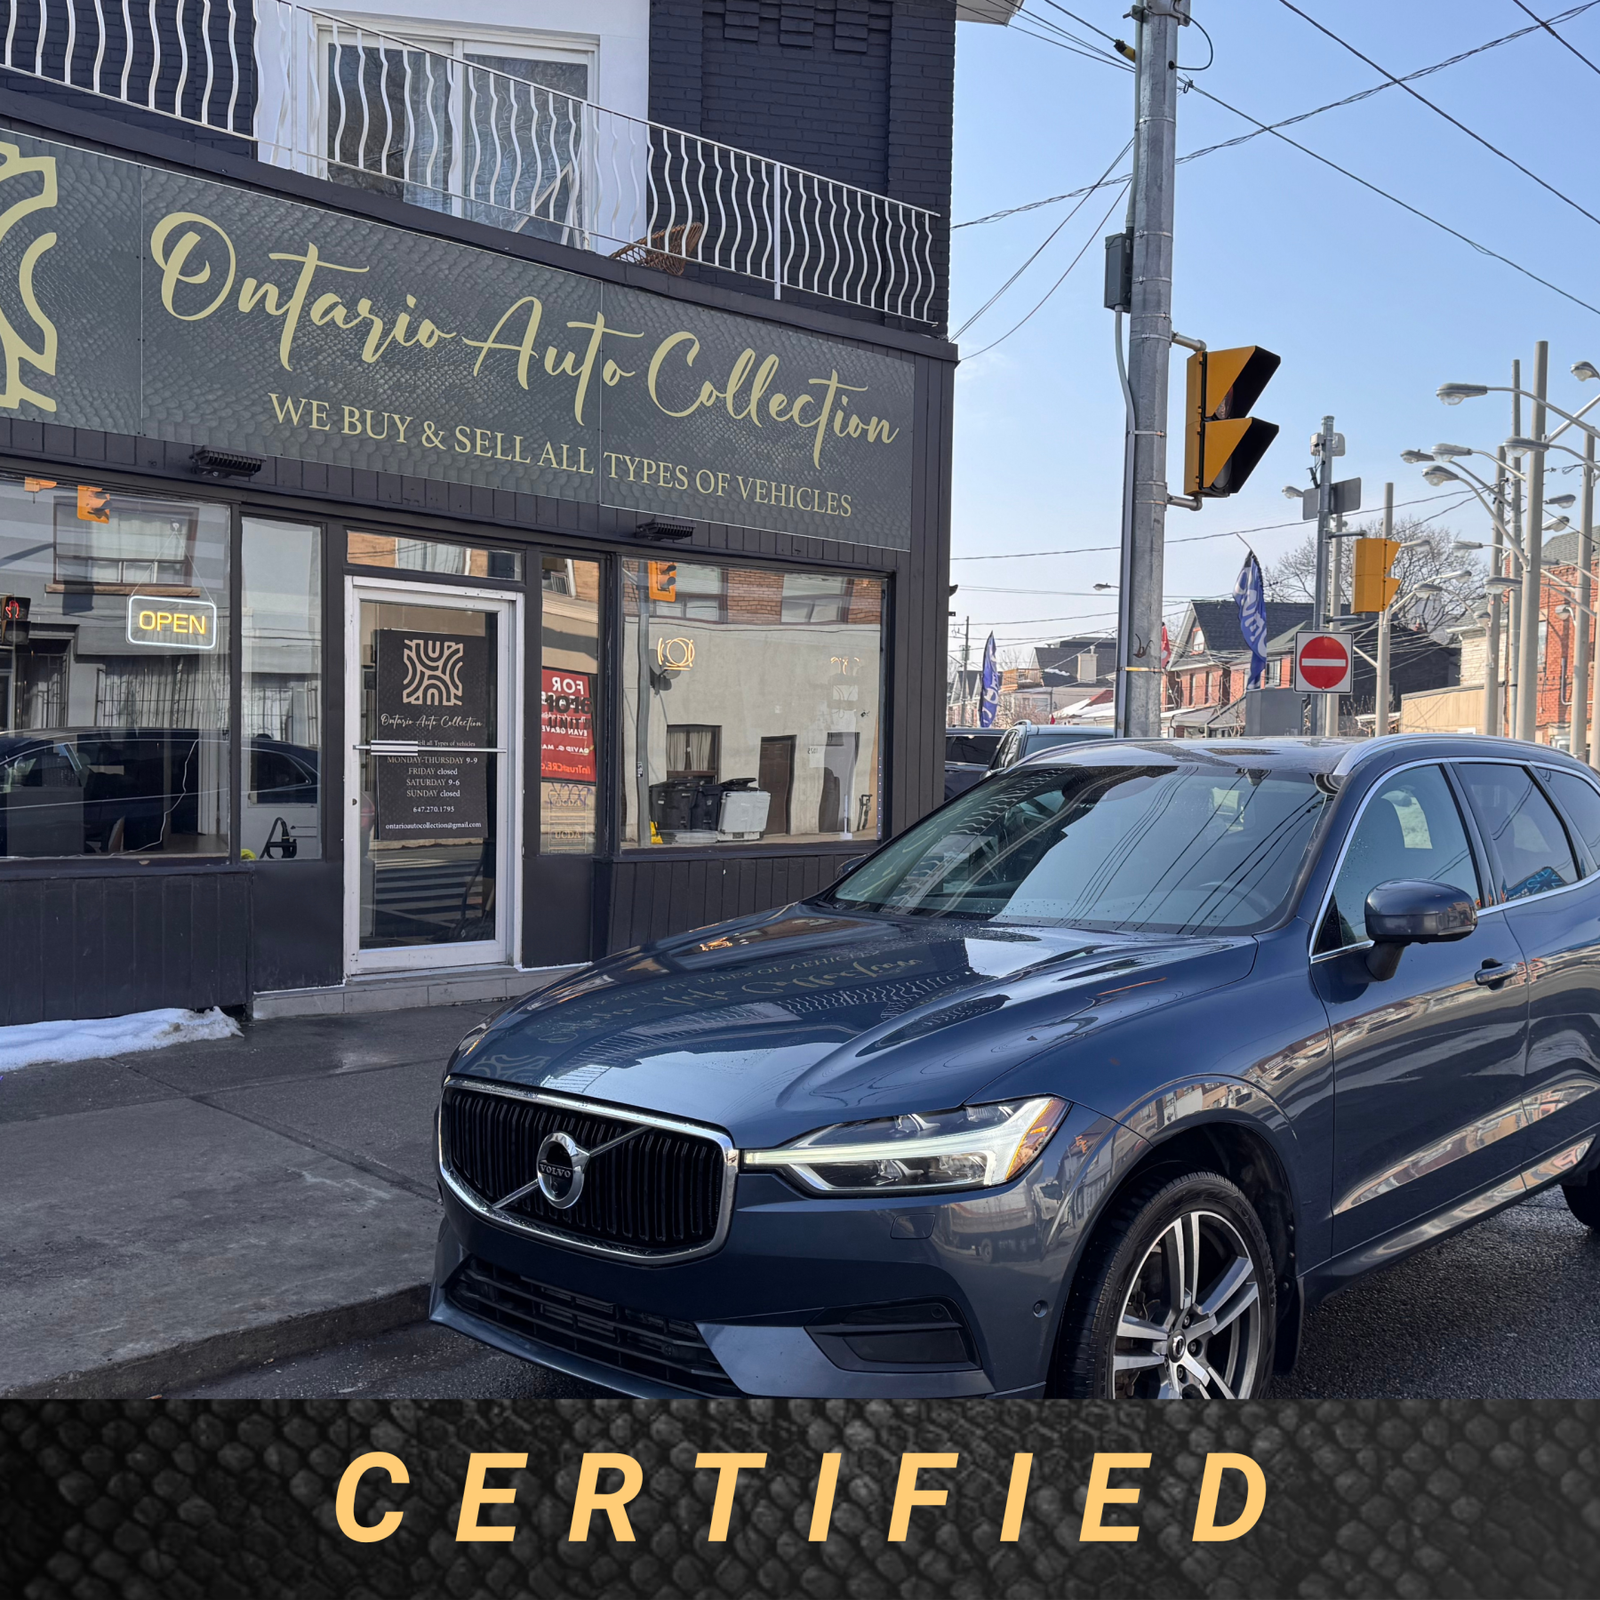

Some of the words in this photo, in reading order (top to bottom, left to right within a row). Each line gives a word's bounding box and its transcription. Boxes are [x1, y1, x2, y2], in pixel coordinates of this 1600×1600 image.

[150, 211, 460, 373] Ontario
[461, 296, 644, 426] Auto
[647, 331, 899, 471] Collection
[269, 392, 331, 431] WE
[340, 404, 413, 444] BUY
[421, 420, 447, 450] &
[454, 425, 531, 464] SELL
[537, 441, 594, 474] ALL
[603, 451, 689, 490] TYPES
[695, 469, 730, 497] OF
[736, 475, 852, 517] VEHICLES
[138, 609, 206, 635] OPEN
[381, 713, 414, 729] Ontario
[415, 715, 440, 730] Auto
[440, 715, 482, 731] Collection
[387, 756, 464, 764] MONDAY-THURSDAY
[408, 767, 436, 775] FRIDAY
[437, 767, 458, 775] closed
[406, 778, 447, 786] SATURDAY
[406, 790, 439, 798] SUNDAY
[385, 821, 482, 830] ontarioautocollection@gmail.com
[539, 1163, 571, 1178] VOLVO
